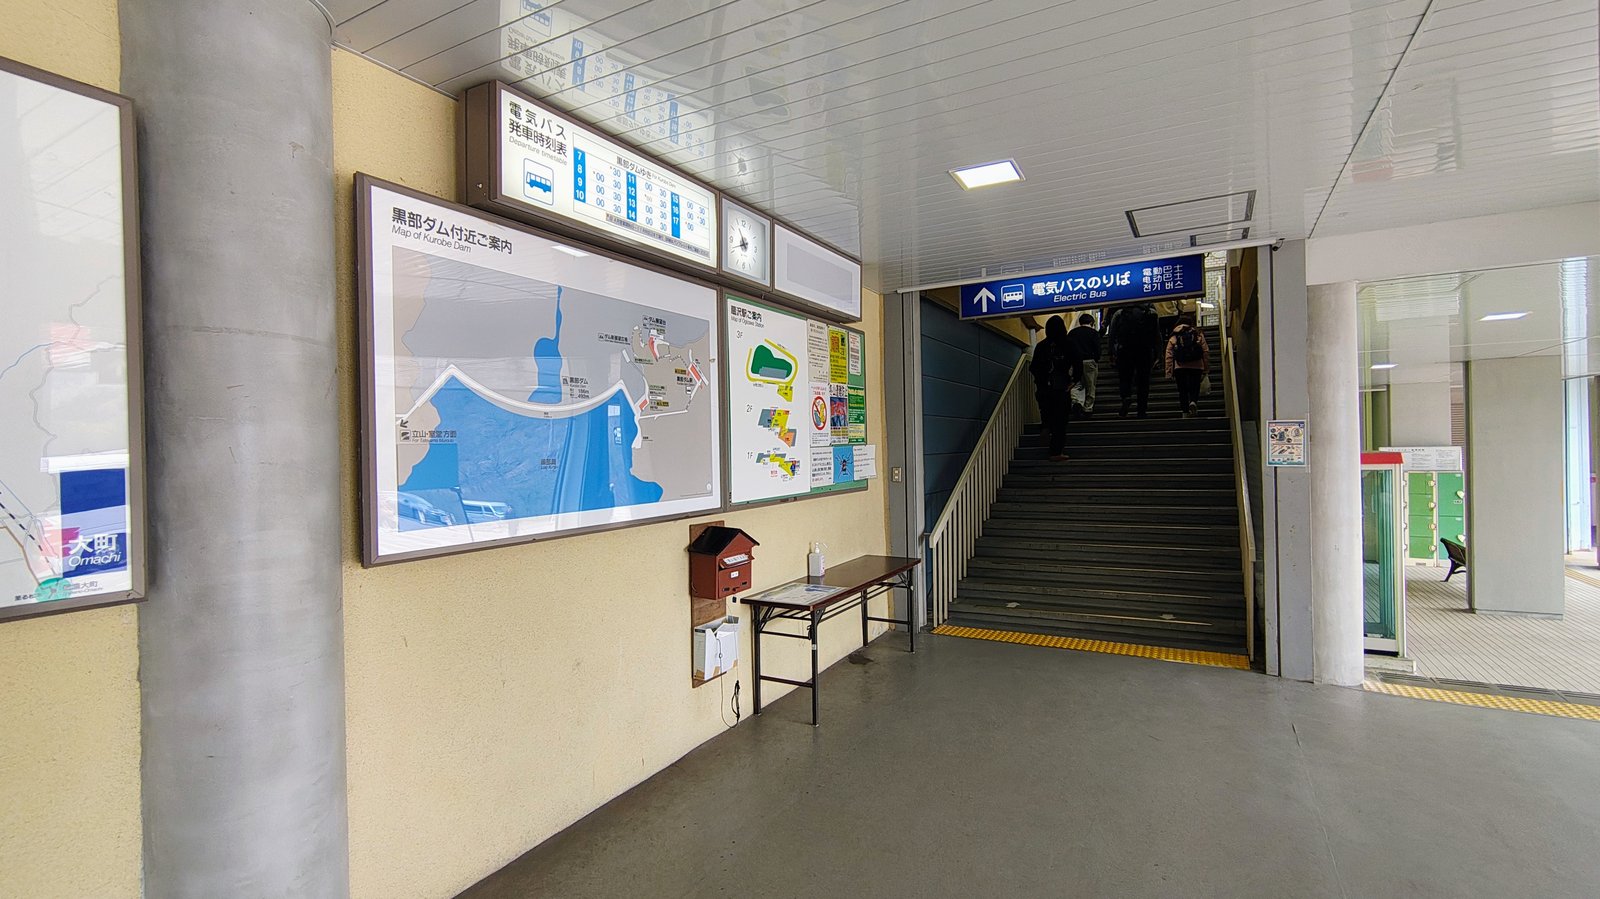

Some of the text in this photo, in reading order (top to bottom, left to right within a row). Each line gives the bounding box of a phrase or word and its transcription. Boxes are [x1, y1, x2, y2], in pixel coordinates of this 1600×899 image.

[509, 101, 567, 140] 電気バス
[509, 118, 567, 158] 発車時刻表
[509, 137, 567, 166] Departure timetable
[577, 151, 621, 178] 7 30
[577, 164, 621, 190] 8 00 30
[627, 174, 667, 198] 11 00 30
[577, 178, 622, 202] 9 00 30
[628, 186, 636, 196] 12
[659, 199, 667, 209] 30
[575, 190, 622, 214] 10 00 30
[628, 197, 667, 220] 13 00 30
[672, 194, 706, 215] 15 00 30
[628, 209, 667, 232] 14 00 30
[672, 216, 694, 232] 17 00
[687, 211, 694, 221] 00
[699, 216, 706, 226] 30
[741, 219, 746, 228] 12
[392, 206, 512, 255] 黒部ダム付近ご案内
[392, 225, 472, 253] Map of Kurobe Dam
[1142, 264, 1184, 276] 電動巴士
[1142, 272, 1184, 284] 电动巴士
[1032, 270, 1131, 297] 電気バスのりば
[1143, 280, 1184, 292] 전기 버스
[1054, 290, 1107, 303] Electric Bus
[737, 330, 743, 339] 3F
[746, 404, 753, 413] 2F
[69, 534, 118, 555] 大町
[69, 552, 121, 567] Omachi
